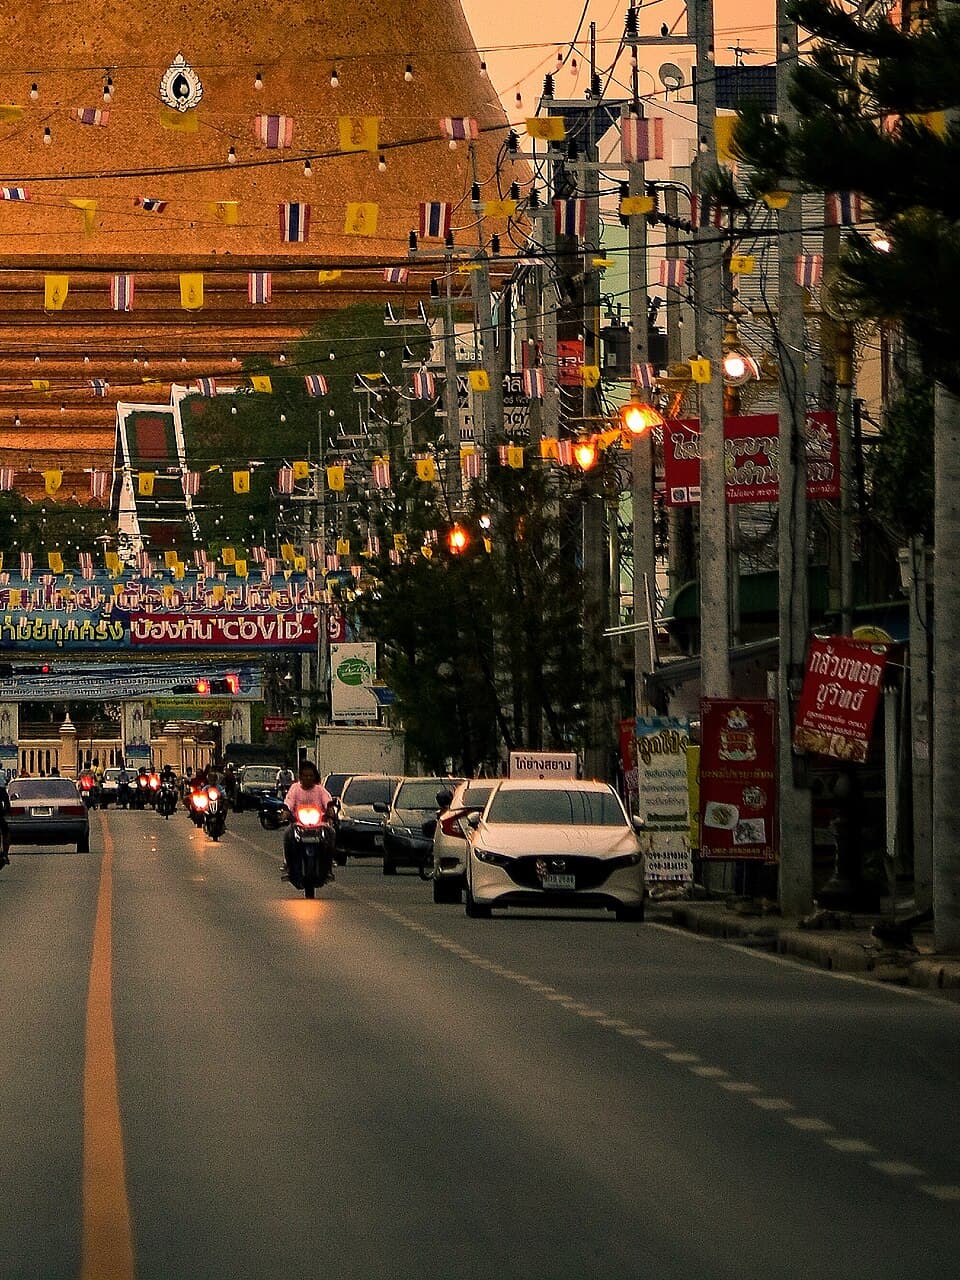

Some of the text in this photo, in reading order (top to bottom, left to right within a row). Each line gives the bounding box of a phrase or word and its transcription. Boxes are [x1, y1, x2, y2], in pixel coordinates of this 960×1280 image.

[515, 756, 571, 770] ไก่ย่างสยาม
